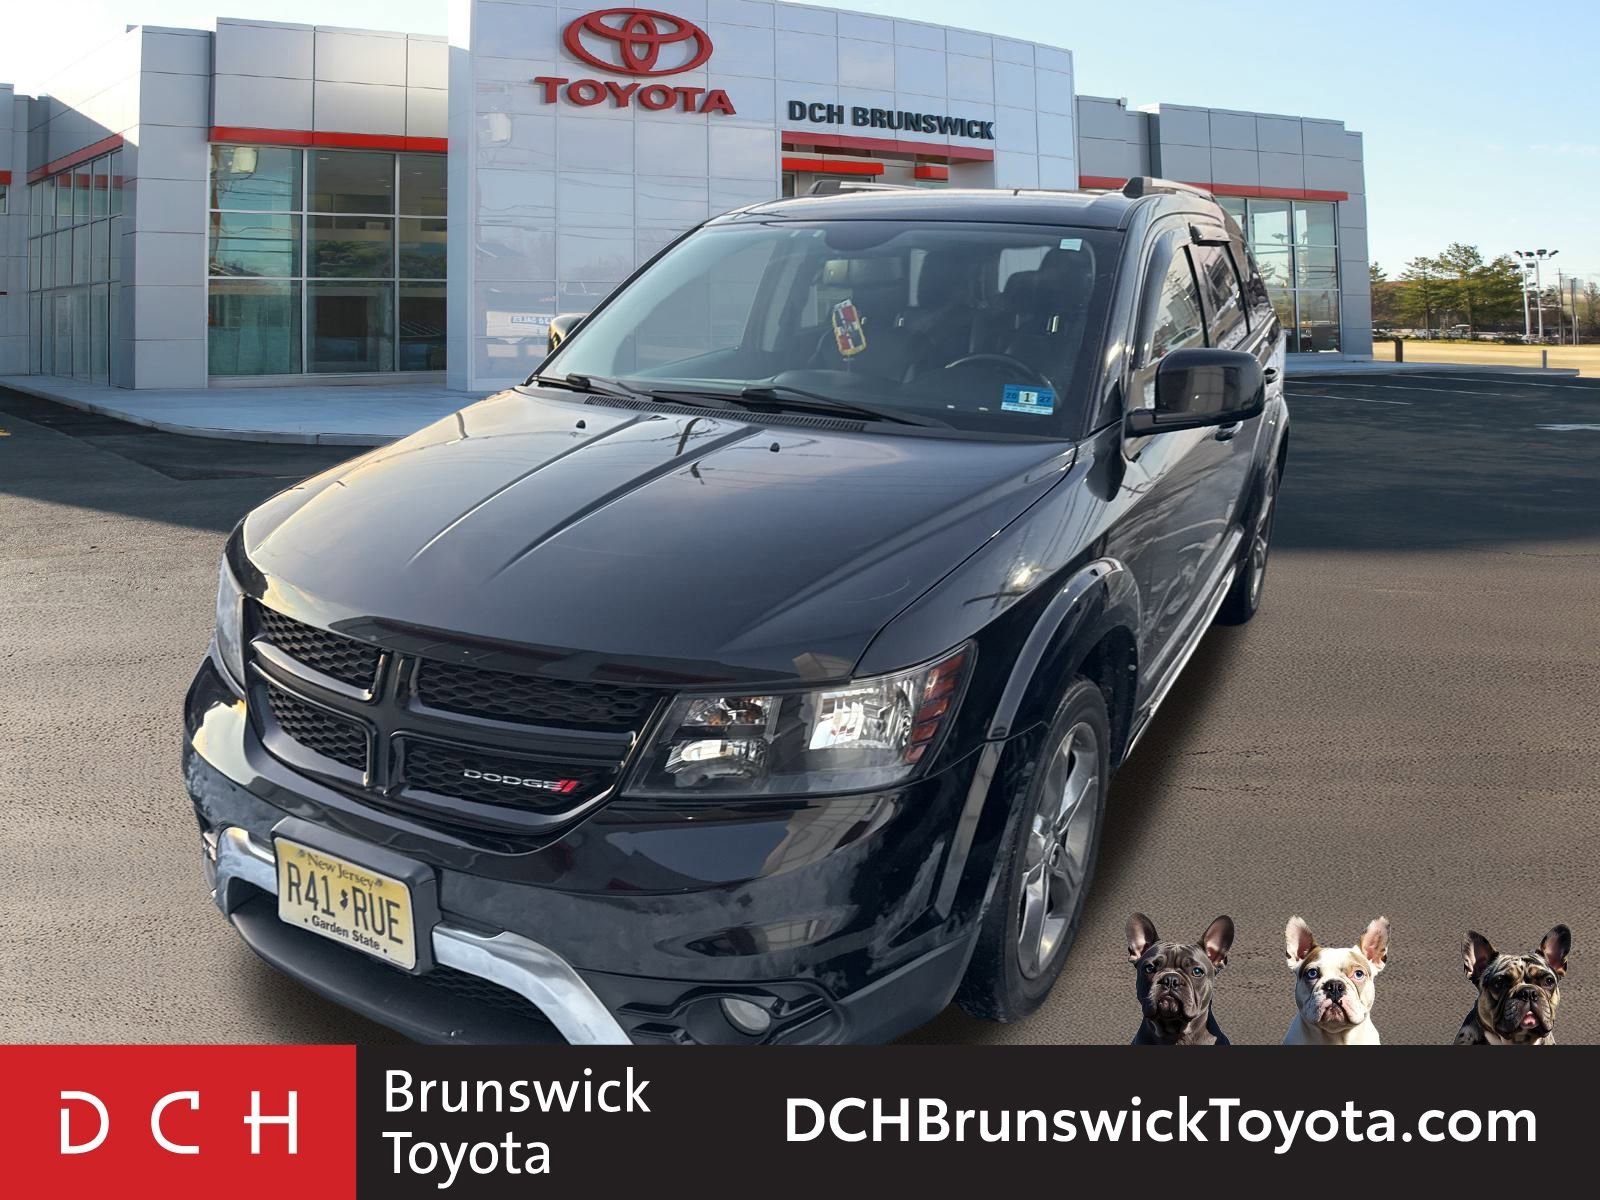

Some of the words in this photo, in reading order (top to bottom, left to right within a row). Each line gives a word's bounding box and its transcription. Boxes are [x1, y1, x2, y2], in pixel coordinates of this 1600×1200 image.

[535, 76, 736, 115] TOYOTA
[788, 101, 844, 124] DCH
[851, 106, 994, 140] BRUNSWICK
[1024, 393, 1030, 402] 1
[464, 769, 562, 791] DODGE
[307, 853, 336, 873] New
[338, 864, 376, 889] Jersey
[287, 861, 336, 918] R41
[352, 886, 403, 945] RUE
[312, 915, 349, 938] Garden
[352, 930, 380, 951] State
